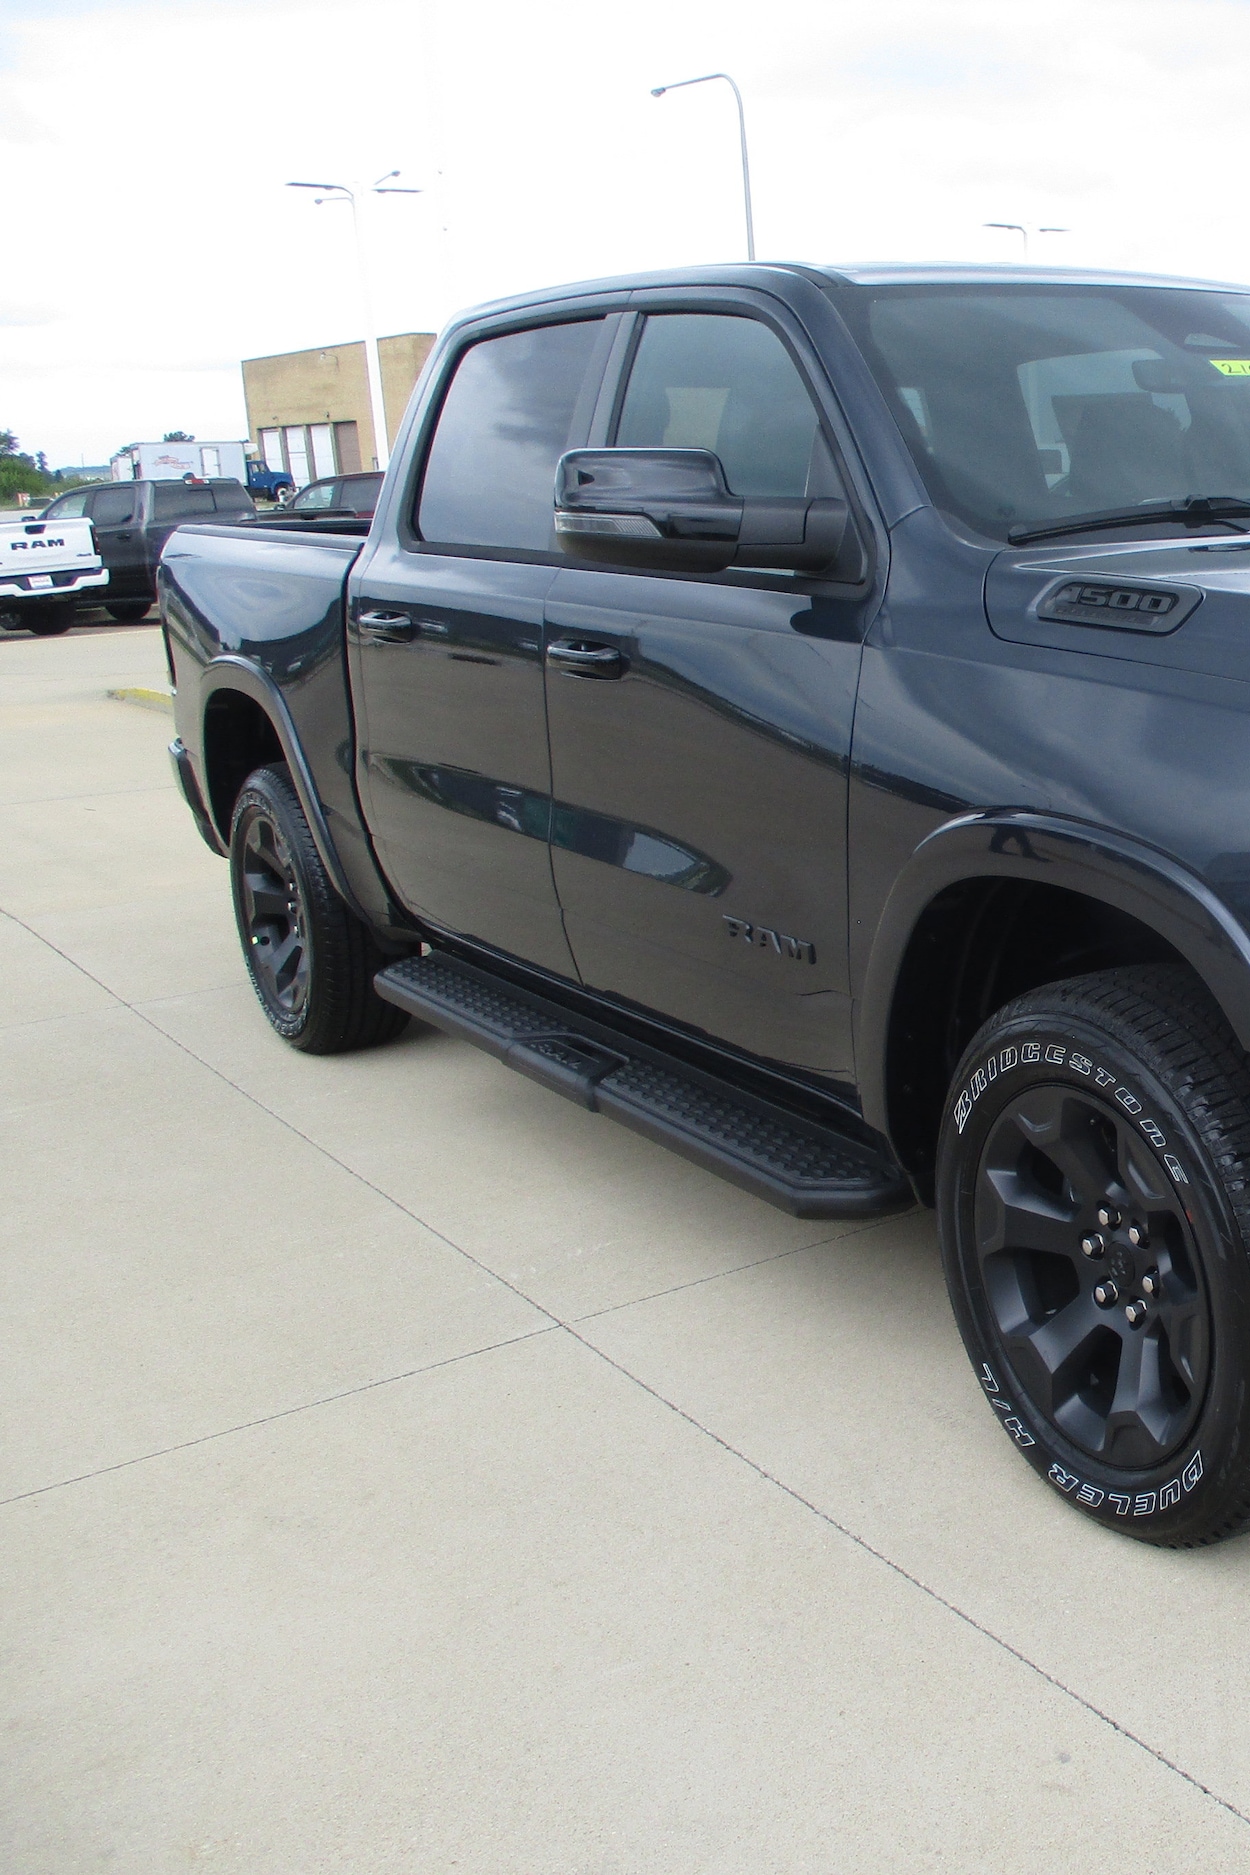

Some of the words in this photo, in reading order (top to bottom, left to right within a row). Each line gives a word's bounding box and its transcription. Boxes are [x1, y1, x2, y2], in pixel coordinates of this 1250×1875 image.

[10, 538, 65, 550] RAM
[1055, 585, 1173, 613] 1500
[722, 914, 817, 965] RAM
[953, 1042, 1190, 1185] BRIDGESTONE
[1048, 1450, 1204, 1517] DUELER
